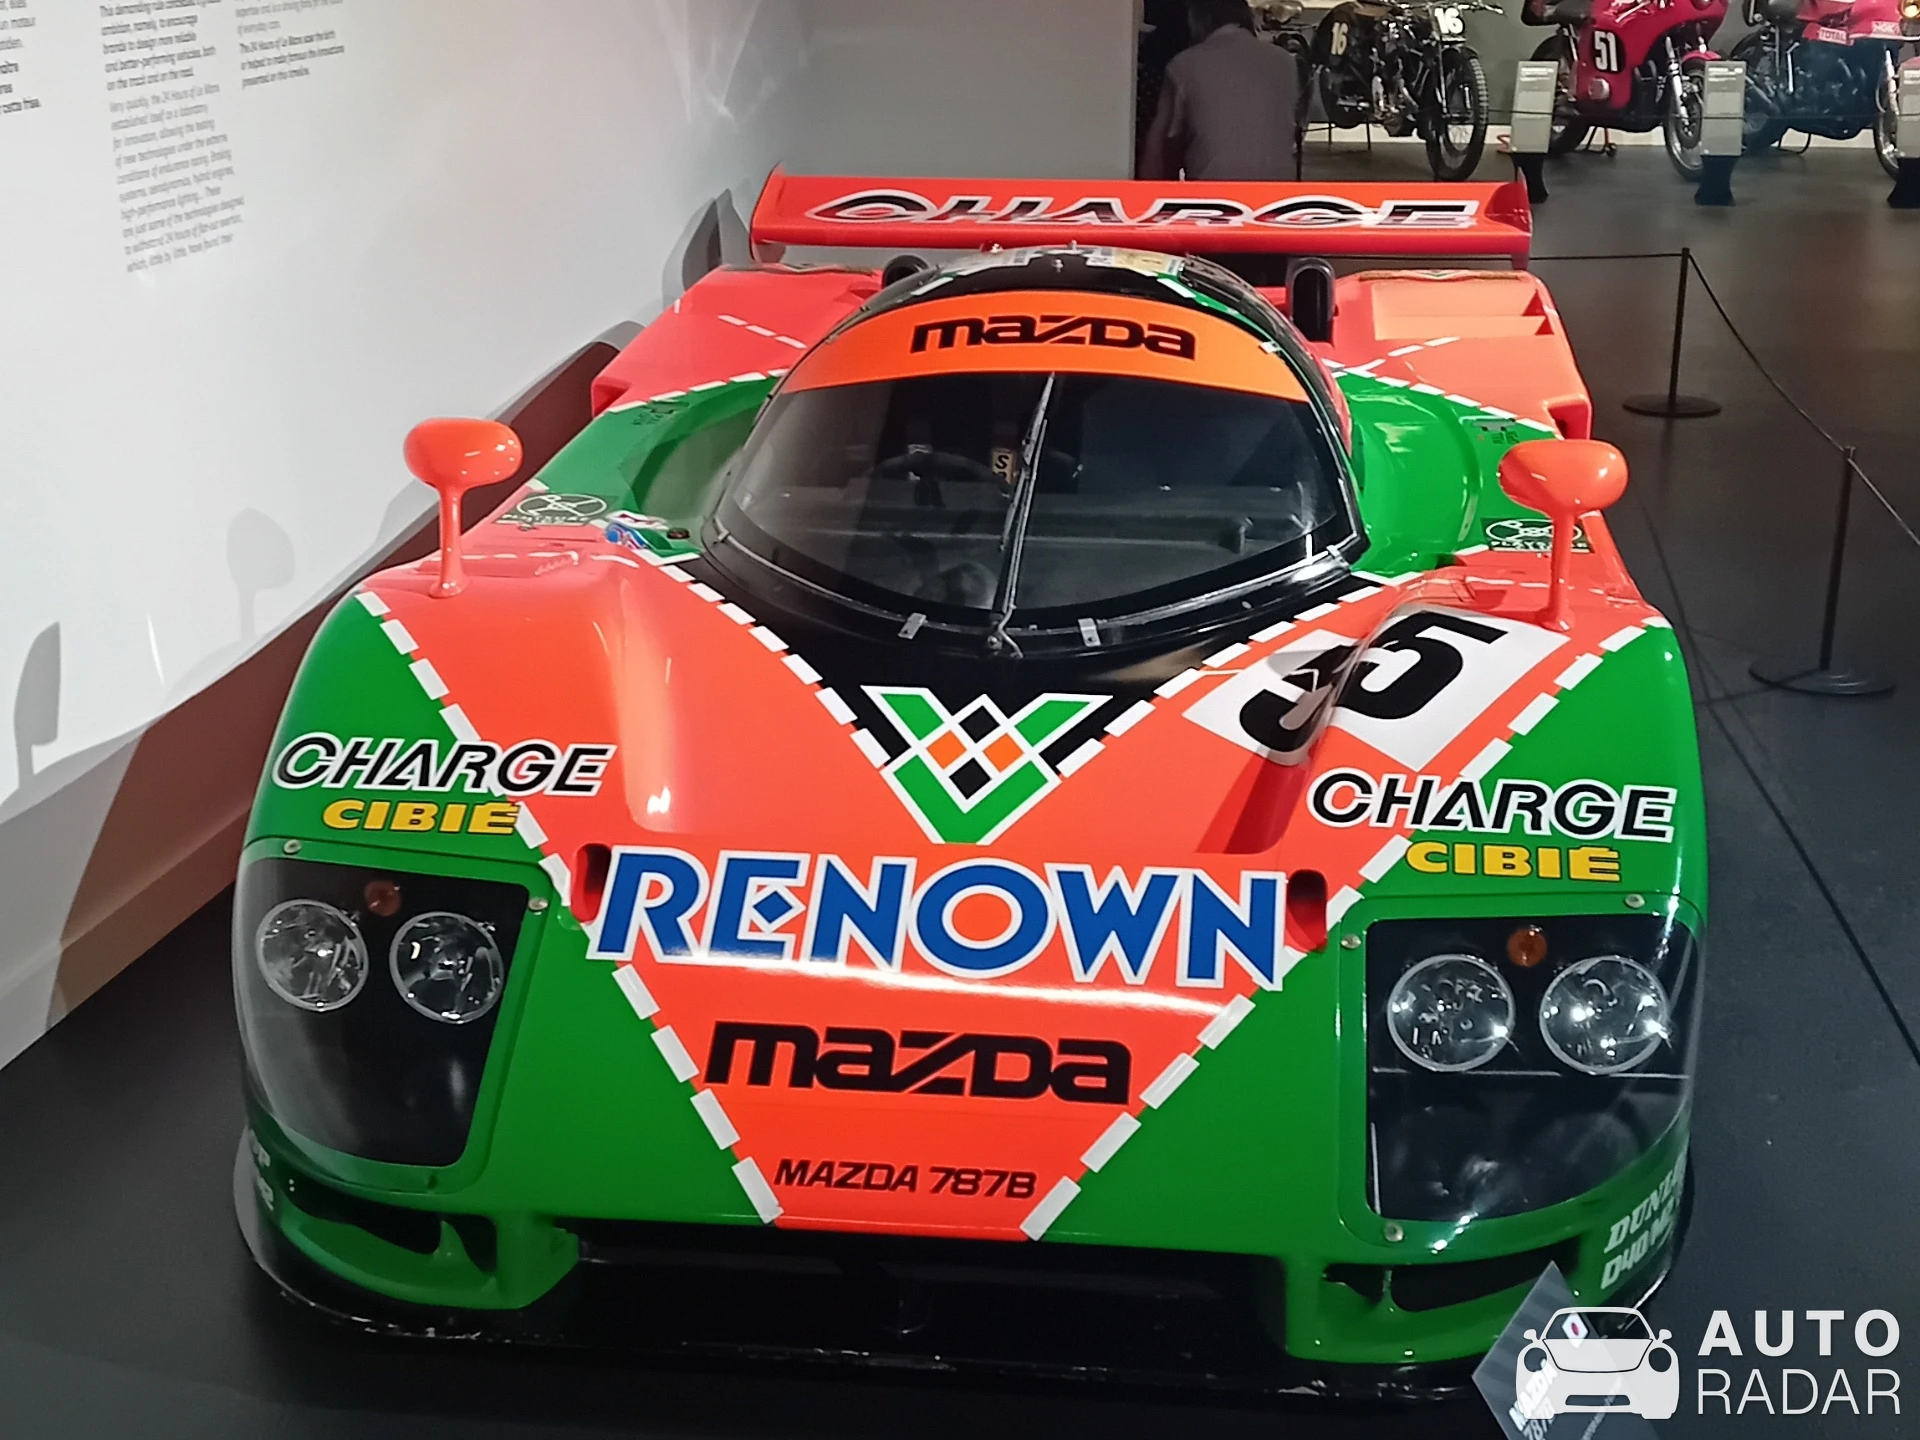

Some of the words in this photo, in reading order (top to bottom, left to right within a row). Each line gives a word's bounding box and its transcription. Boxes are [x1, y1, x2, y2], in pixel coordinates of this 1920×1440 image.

[1332, 22, 1348, 55] 16
[1435, 8, 1464, 34] 16
[1594, 30, 1618, 72] 51
[805, 188, 1479, 228] CHARGE
[271, 732, 617, 796] CHARGE
[322, 799, 520, 834] CIBIÉ
[1308, 767, 1678, 842] CHARGE
[1404, 841, 1622, 883] CIBIÉ
[587, 845, 1286, 992] RENOWN
[774, 1158, 918, 1194] MAZDA
[929, 1164, 1038, 1199] 787B
